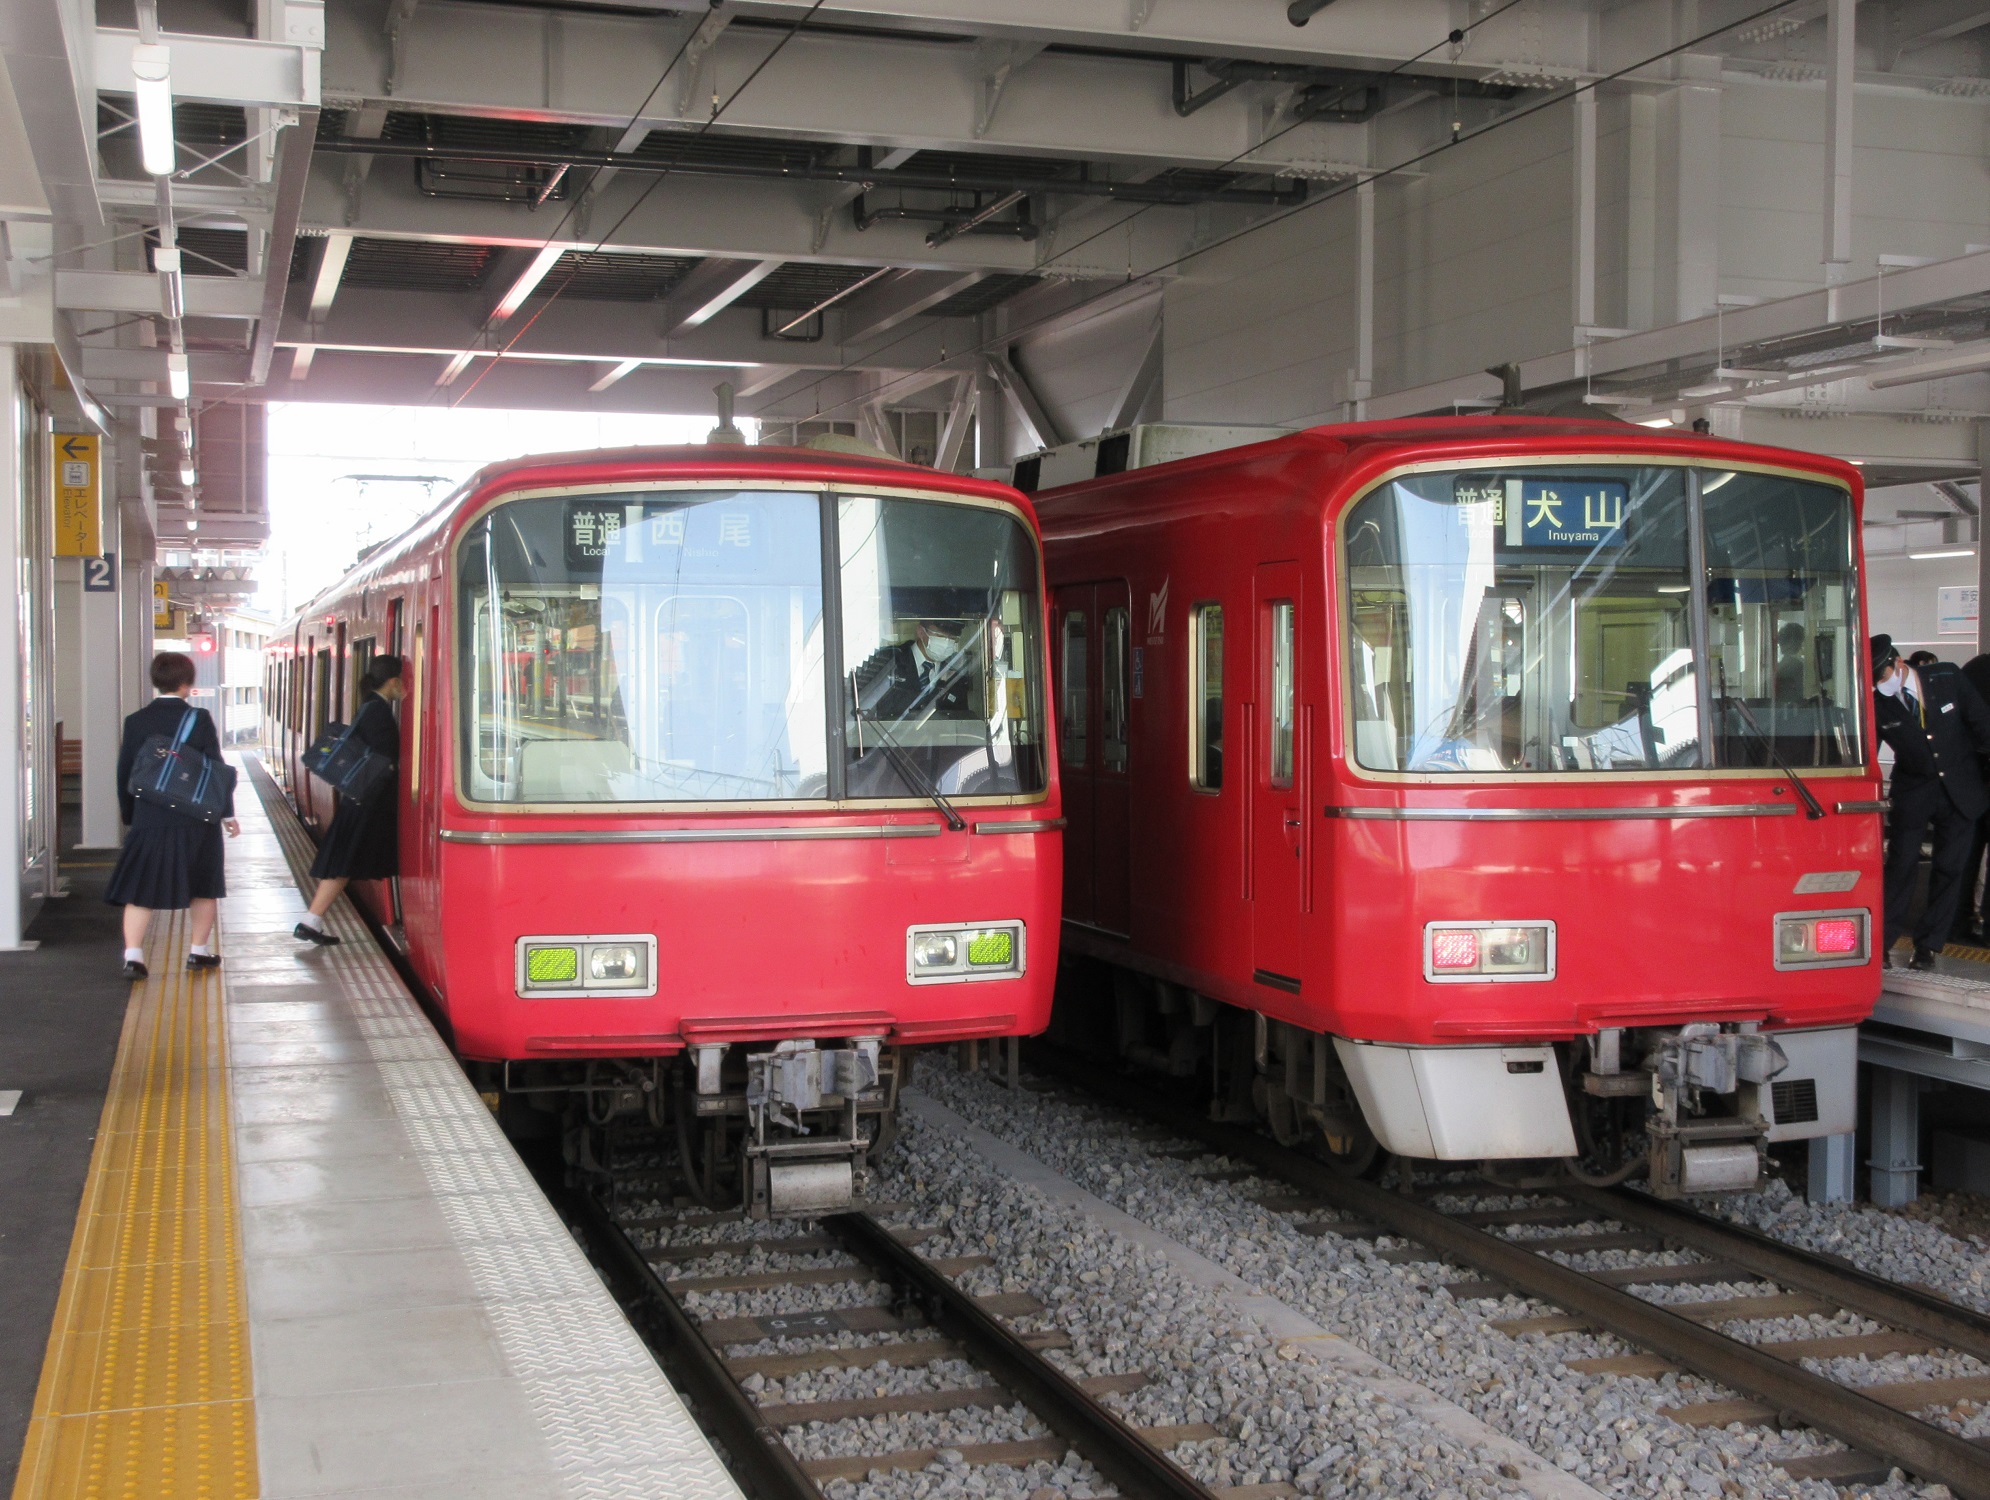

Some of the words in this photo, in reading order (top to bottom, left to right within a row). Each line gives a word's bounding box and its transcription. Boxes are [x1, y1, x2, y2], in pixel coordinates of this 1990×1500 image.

[63, 489, 72, 528] Elevator
[74, 488, 88, 552] エレベーター
[1455, 487, 1504, 526] 普通
[1527, 490, 1622, 529] 犬山
[572, 511, 621, 546] 普通
[650, 511, 752, 547] 西尾
[1548, 530, 1599, 543] Inuyama
[583, 547, 611, 556] Local
[89, 559, 110, 586] 2
